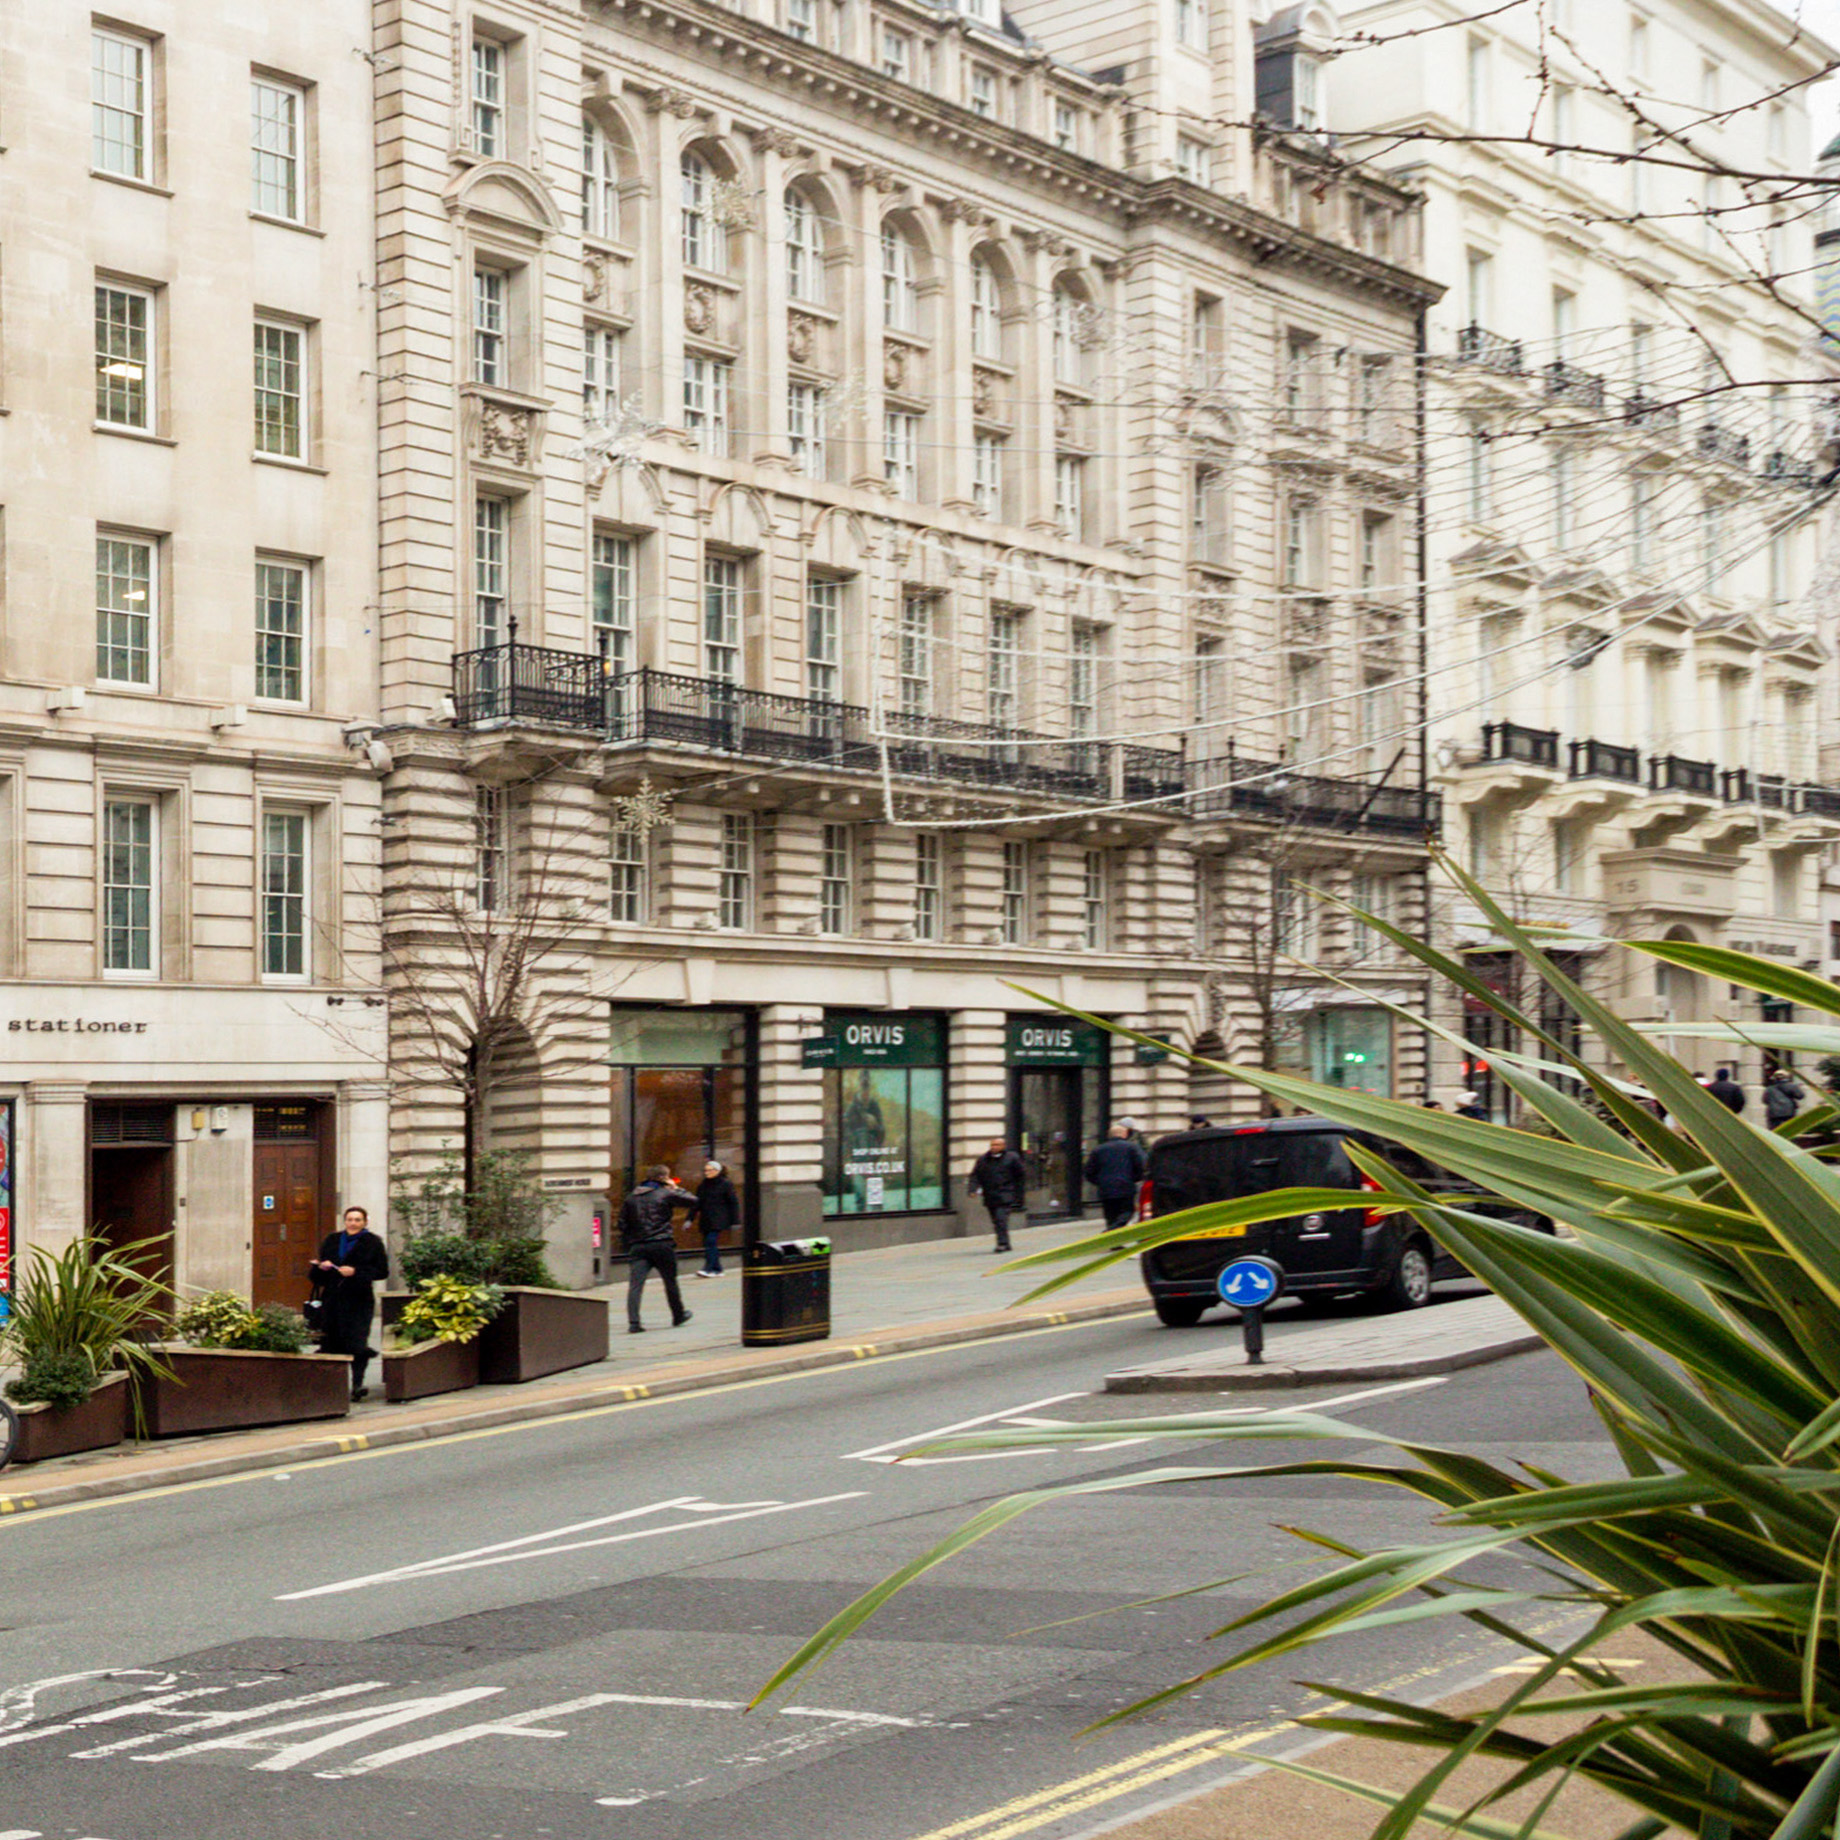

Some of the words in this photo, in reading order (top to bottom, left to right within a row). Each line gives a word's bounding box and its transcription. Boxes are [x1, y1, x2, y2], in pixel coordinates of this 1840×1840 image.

[8, 1017, 148, 1033] stationer
[846, 1024, 905, 1045] ORVIS
[1022, 1028, 1073, 1048] ORVIS
[844, 1161, 905, 1175] ORVIS.CO.UK
